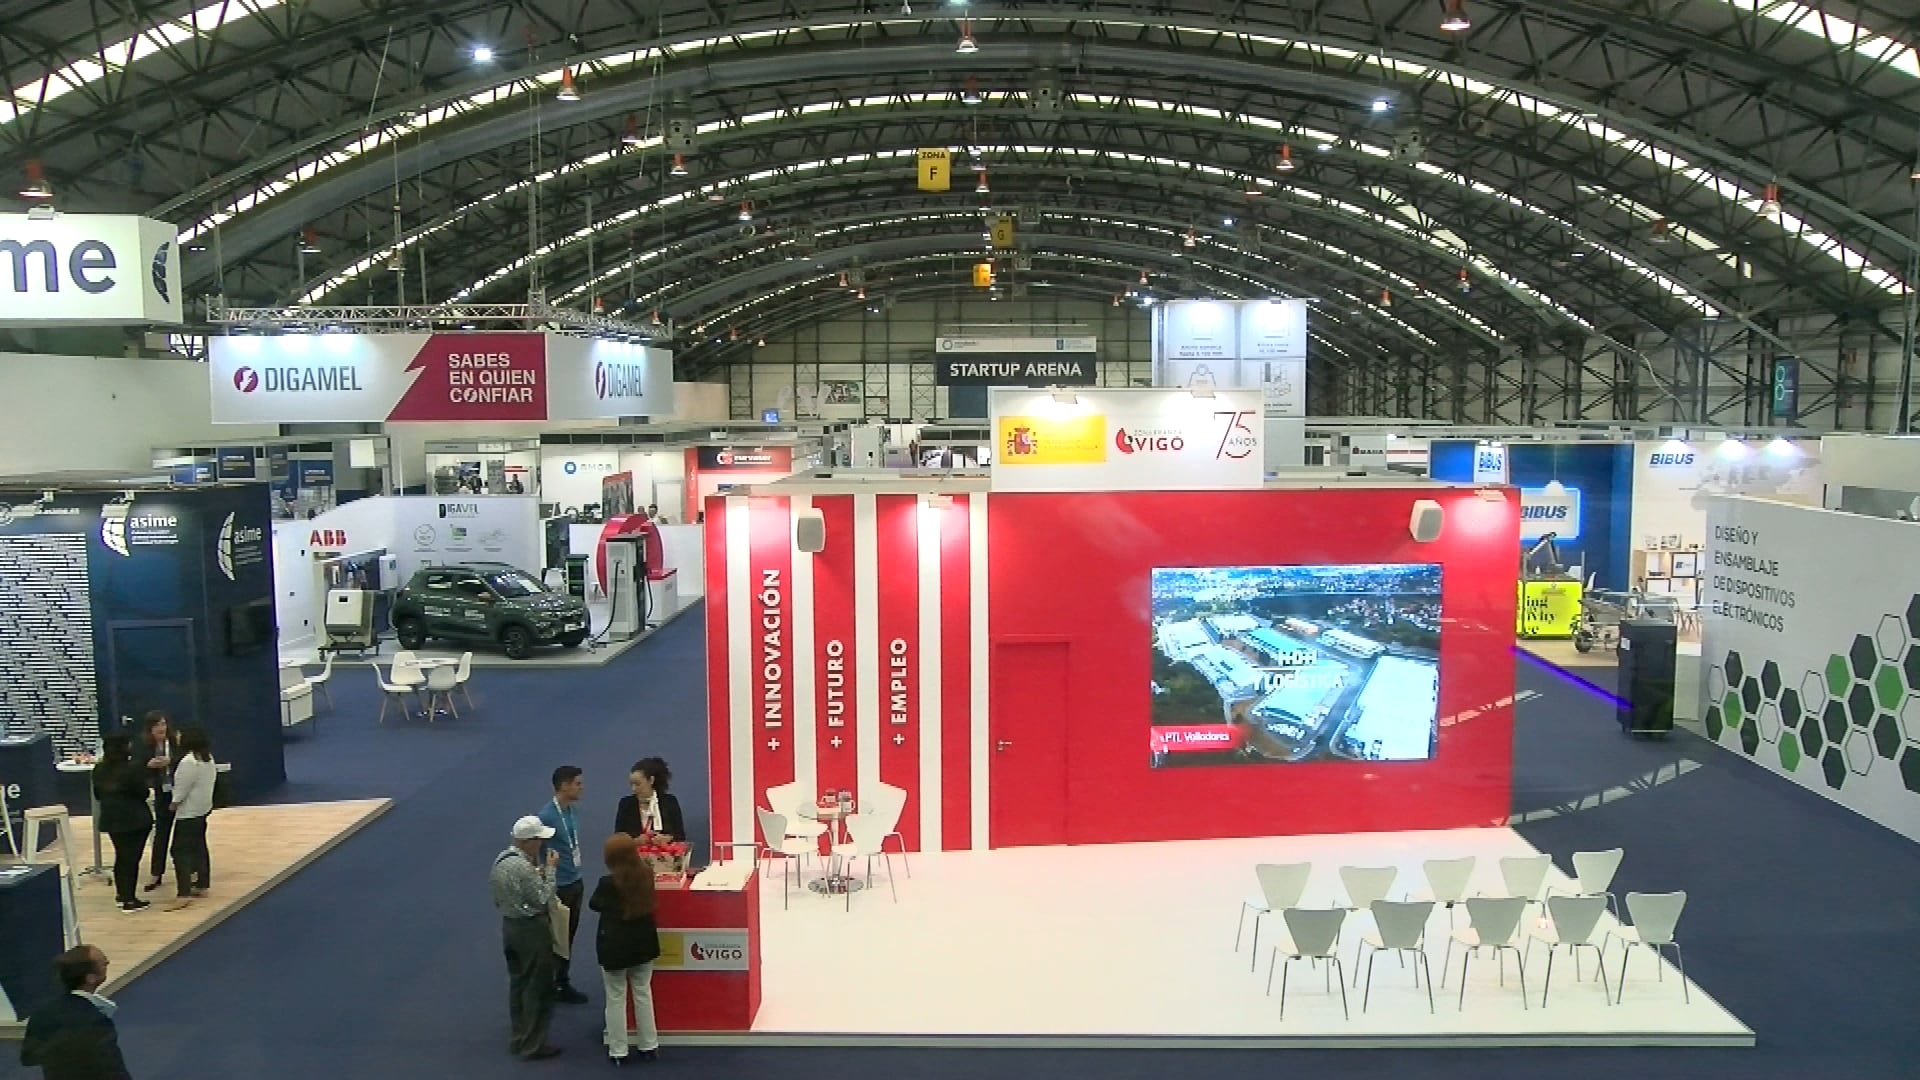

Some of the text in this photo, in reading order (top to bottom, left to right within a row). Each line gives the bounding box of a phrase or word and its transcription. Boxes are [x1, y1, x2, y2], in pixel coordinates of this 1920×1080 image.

[922, 151, 946, 159] ZONA
[929, 167, 938, 181] F
[448, 353, 511, 367] SABES
[264, 366, 363, 392] DIGAMEL
[449, 369, 536, 387] EN QUIEN
[950, 363, 1082, 377] STARTUP ARENA
[607, 363, 643, 398] DIGAMEL
[449, 387, 533, 403] CONFIAR
[1134, 437, 1184, 451] VIGO
[1213, 411, 1256, 460] 75
[1650, 453, 1695, 465] BIBUS
[1520, 504, 1568, 519] BIBUS
[130, 513, 177, 529] asime
[234, 525, 262, 545] asime
[310, 529, 347, 546] ABB
[1715, 525, 1759, 545] DISEÑO Y
[1714, 550, 1779, 577] ENSAMBLAJE
[1713, 575, 1795, 609] DE DISPOSITIVOS
[1712, 599, 1784, 633] ELECTRÓNICOS
[758, 569, 782, 728] INNOVACIÓN
[826, 639, 844, 727] FUTURO
[890, 638, 907, 724] EMPLEO
[705, 949, 743, 960] VIGO
